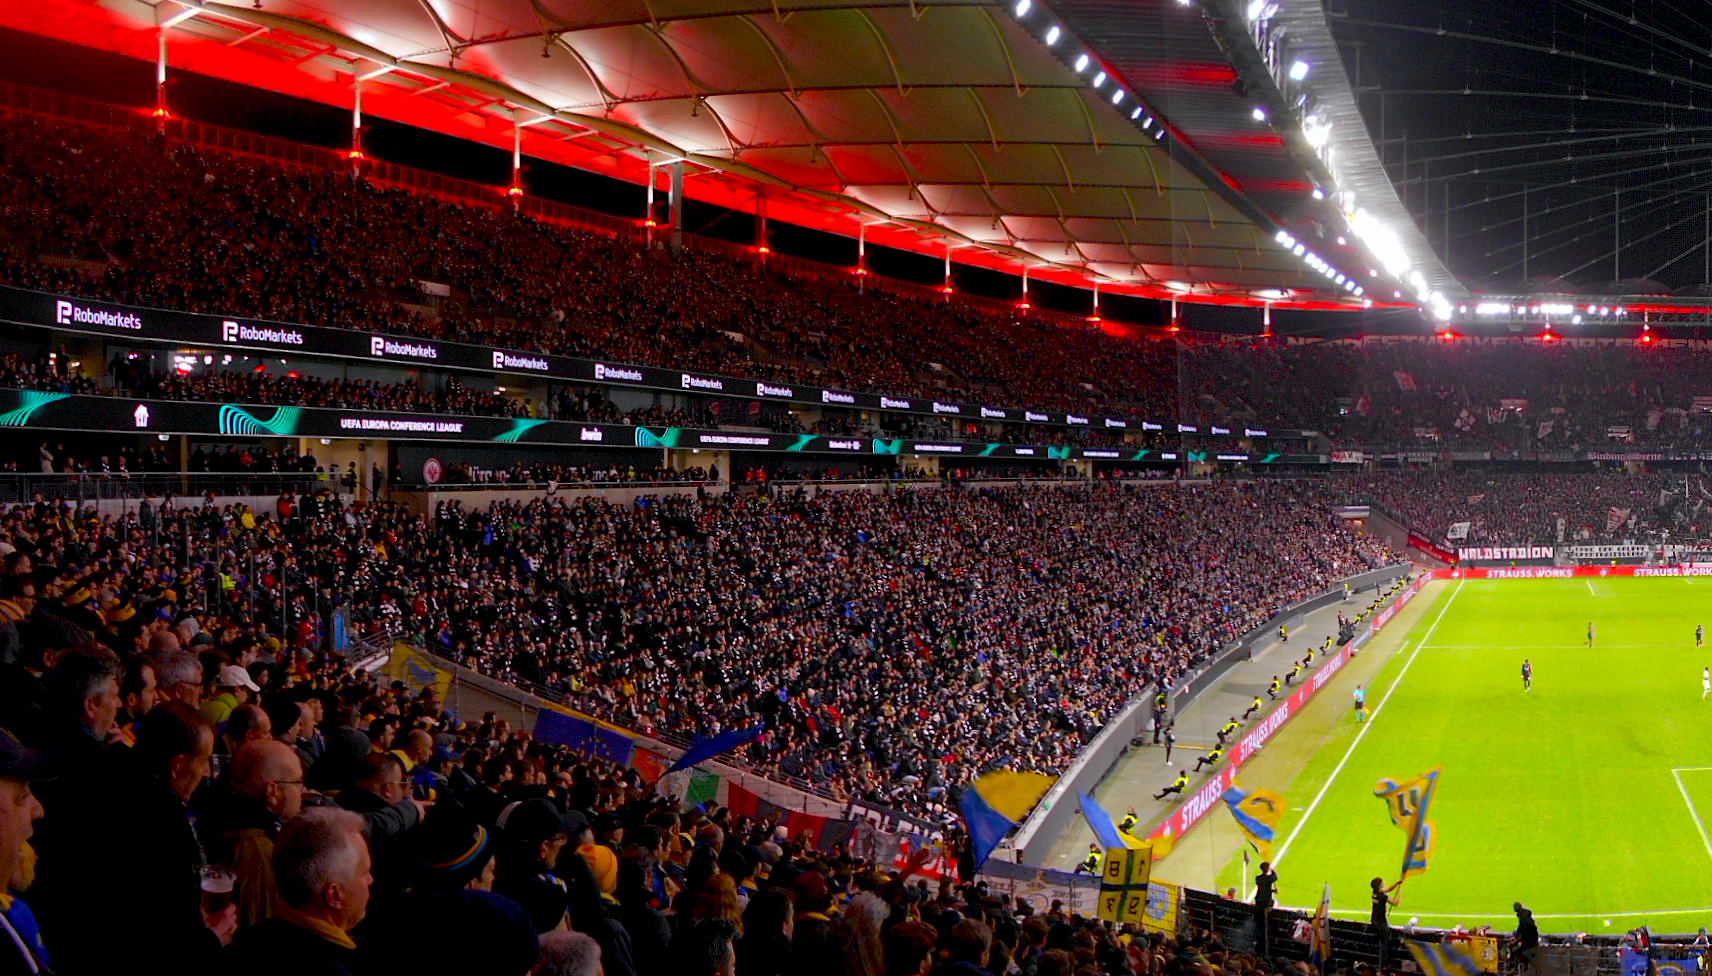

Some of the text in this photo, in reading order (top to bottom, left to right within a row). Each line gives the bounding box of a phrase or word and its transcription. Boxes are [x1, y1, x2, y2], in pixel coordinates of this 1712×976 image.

[74, 307, 142, 330] RoboMarkets
[240, 326, 303, 345] RoboMarkets
[385, 342, 437, 360] RoboMarkets
[504, 357, 549, 371] RoboMarkets
[605, 368, 642, 381] RoboMarkets
[341, 418, 463, 433] UEFA EUROPA CONFERENCE LEAGUE
[581, 427, 602, 441] bwin
[1458, 547, 1554, 560] WALDSTADION
[1487, 569, 1573, 579] STRAUSS.WORKS
[1181, 775, 1223, 830] STRAUSS
